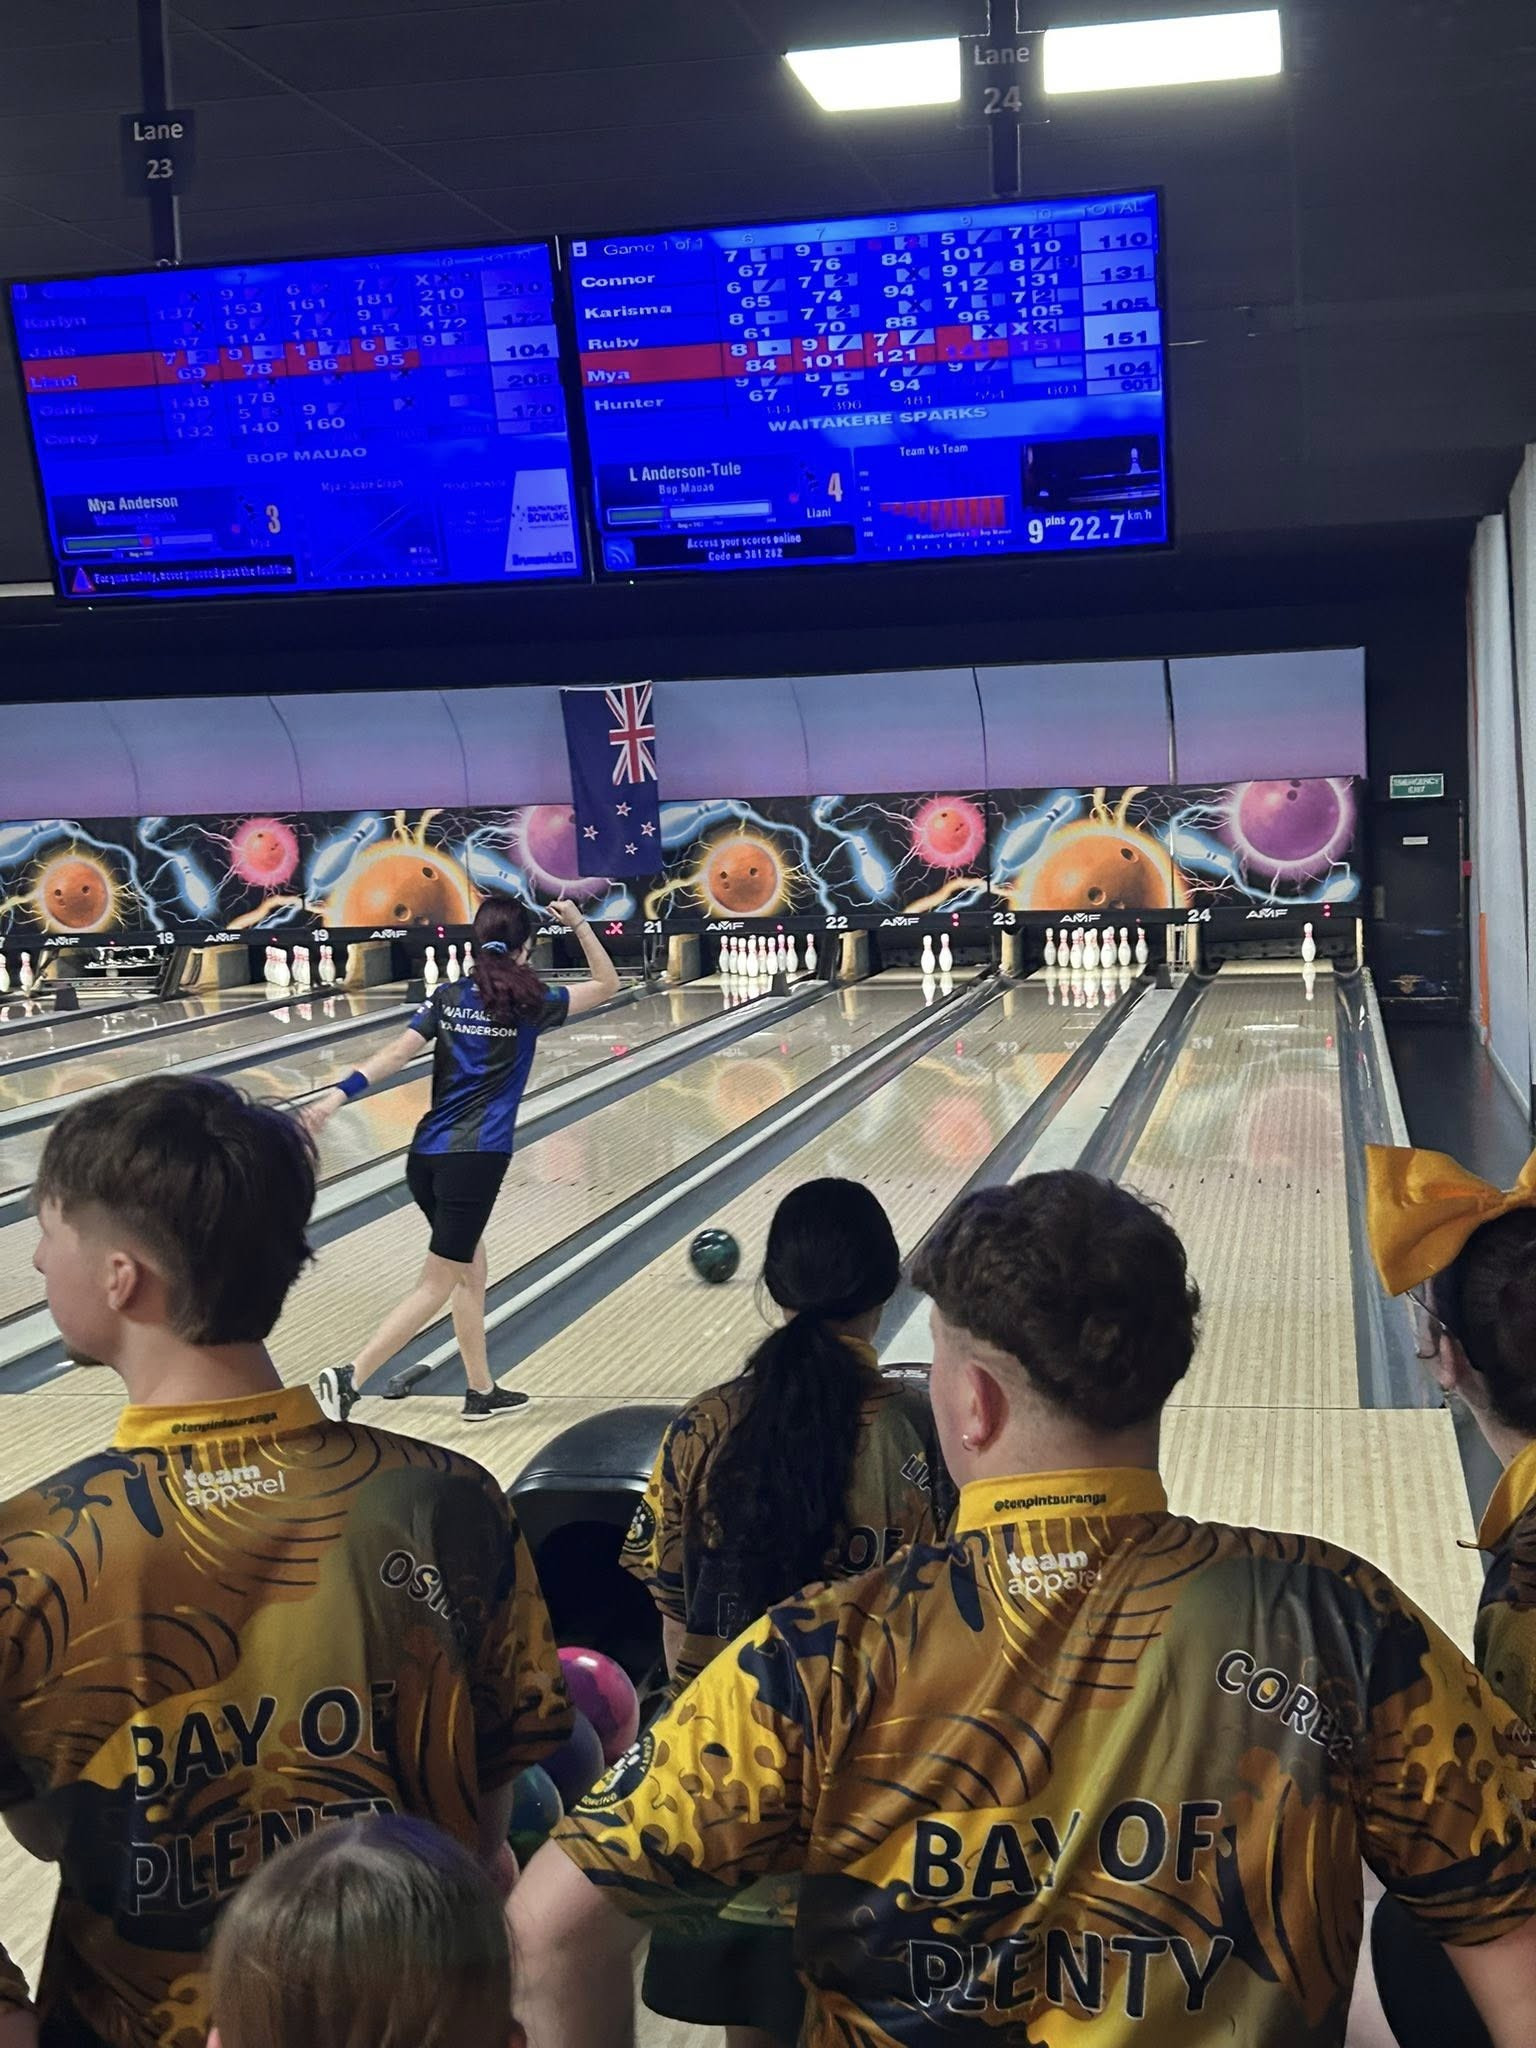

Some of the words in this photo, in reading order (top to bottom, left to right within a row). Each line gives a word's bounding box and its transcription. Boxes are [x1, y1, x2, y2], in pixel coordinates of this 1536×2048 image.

[974, 45, 1030, 66] Lane
[984, 85, 1022, 114] 24
[134, 122, 183, 141] Lane
[147, 158, 174, 179] 23
[604, 243, 655, 256] Game
[675, 239, 690, 250] of
[738, 264, 767, 277] 67
[810, 258, 841, 271] 76
[881, 254, 912, 265] 84
[941, 247, 984, 261] 101
[1015, 240, 1061, 255] 110
[1099, 232, 1148, 249] 110
[795, 245, 811, 256] 9
[941, 233, 955, 245] 5
[1009, 228, 1022, 239] 7
[581, 274, 656, 288] Connor
[727, 282, 742, 294] 6
[798, 276, 812, 288] 7
[943, 265, 958, 277] 9
[1009, 260, 1025, 271] 8
[741, 296, 771, 308] 65
[812, 290, 842, 303] 74
[884, 285, 914, 297] 94
[943, 279, 988, 293] 112
[1016, 273, 1059, 287] 131
[1100, 265, 1146, 281] 131
[222, 302, 263, 316] 153
[288, 297, 326, 311] 161
[355, 292, 392, 306] 181
[419, 287, 464, 302] 210
[584, 304, 672, 319] Karisma
[729, 313, 744, 326] 8
[801, 309, 814, 321] 7
[945, 297, 958, 309] 7
[743, 327, 770, 340] 61
[814, 322, 845, 334] 70
[885, 317, 917, 328] 88
[957, 311, 990, 323] 96
[1017, 305, 1063, 318] 105
[1101, 297, 1149, 311] 105
[361, 340, 376, 352] 6
[422, 336, 436, 347] 9
[731, 343, 748, 356] 8
[802, 339, 818, 351] 9
[874, 333, 889, 346] 7
[745, 359, 776, 372] 84
[802, 355, 845, 369] 101
[874, 350, 916, 364] 121
[1103, 331, 1148, 345] 151
[177, 367, 207, 380] 69
[241, 363, 273, 376] 78
[307, 358, 338, 371] 86
[374, 354, 405, 367] 95
[506, 344, 550, 358] 104
[587, 369, 631, 383] Mya
[749, 389, 778, 402] 67
[819, 384, 850, 397] 75
[890, 379, 920, 391] 94
[1104, 361, 1152, 376] 104
[594, 398, 664, 411] Hunter
[304, 416, 346, 431] 160
[768, 413, 893, 432] WAITAKERE
[900, 408, 987, 423] SPARKS
[247, 451, 289, 464] BOP
[294, 447, 368, 461] MAUAO
[900, 445, 925, 457] Team
[929, 445, 940, 455] Vs
[943, 443, 968, 454] Team
[630, 468, 637, 482] L
[642, 462, 742, 481] Anderson-Tule
[827, 472, 843, 502] 4
[88, 497, 115, 515] Mya
[119, 495, 179, 511] Anderson
[266, 504, 282, 534] 3
[1028, 519, 1044, 544] 9
[1046, 515, 1066, 528] pins
[1069, 515, 1125, 541] 22.7
[44, 937, 80, 947] AMF
[204, 933, 242, 943] AMF
[370, 929, 407, 938] AMF
[705, 921, 745, 931] AMF
[879, 917, 920, 927] AMF
[1059, 912, 1101, 923] AMF
[1246, 908, 1289, 919] AMF
[157, 932, 175, 944] 18
[312, 929, 329, 941] 19
[644, 921, 663, 933] 21
[825, 916, 849, 929] 22
[993, 912, 1016, 926] 23
[1188, 908, 1212, 923] 24
[454, 1024, 517, 1037] ANDERSON
[183, 1464, 261, 1488] team
[185, 1470, 286, 1510] apparel
[1007, 1550, 1089, 1576] team
[130, 1696, 277, 1801] BAY
[911, 1808, 1082, 1902] BAY
[1098, 1797, 1222, 1886] OF
[908, 1928, 1234, 2021] PLENTY
